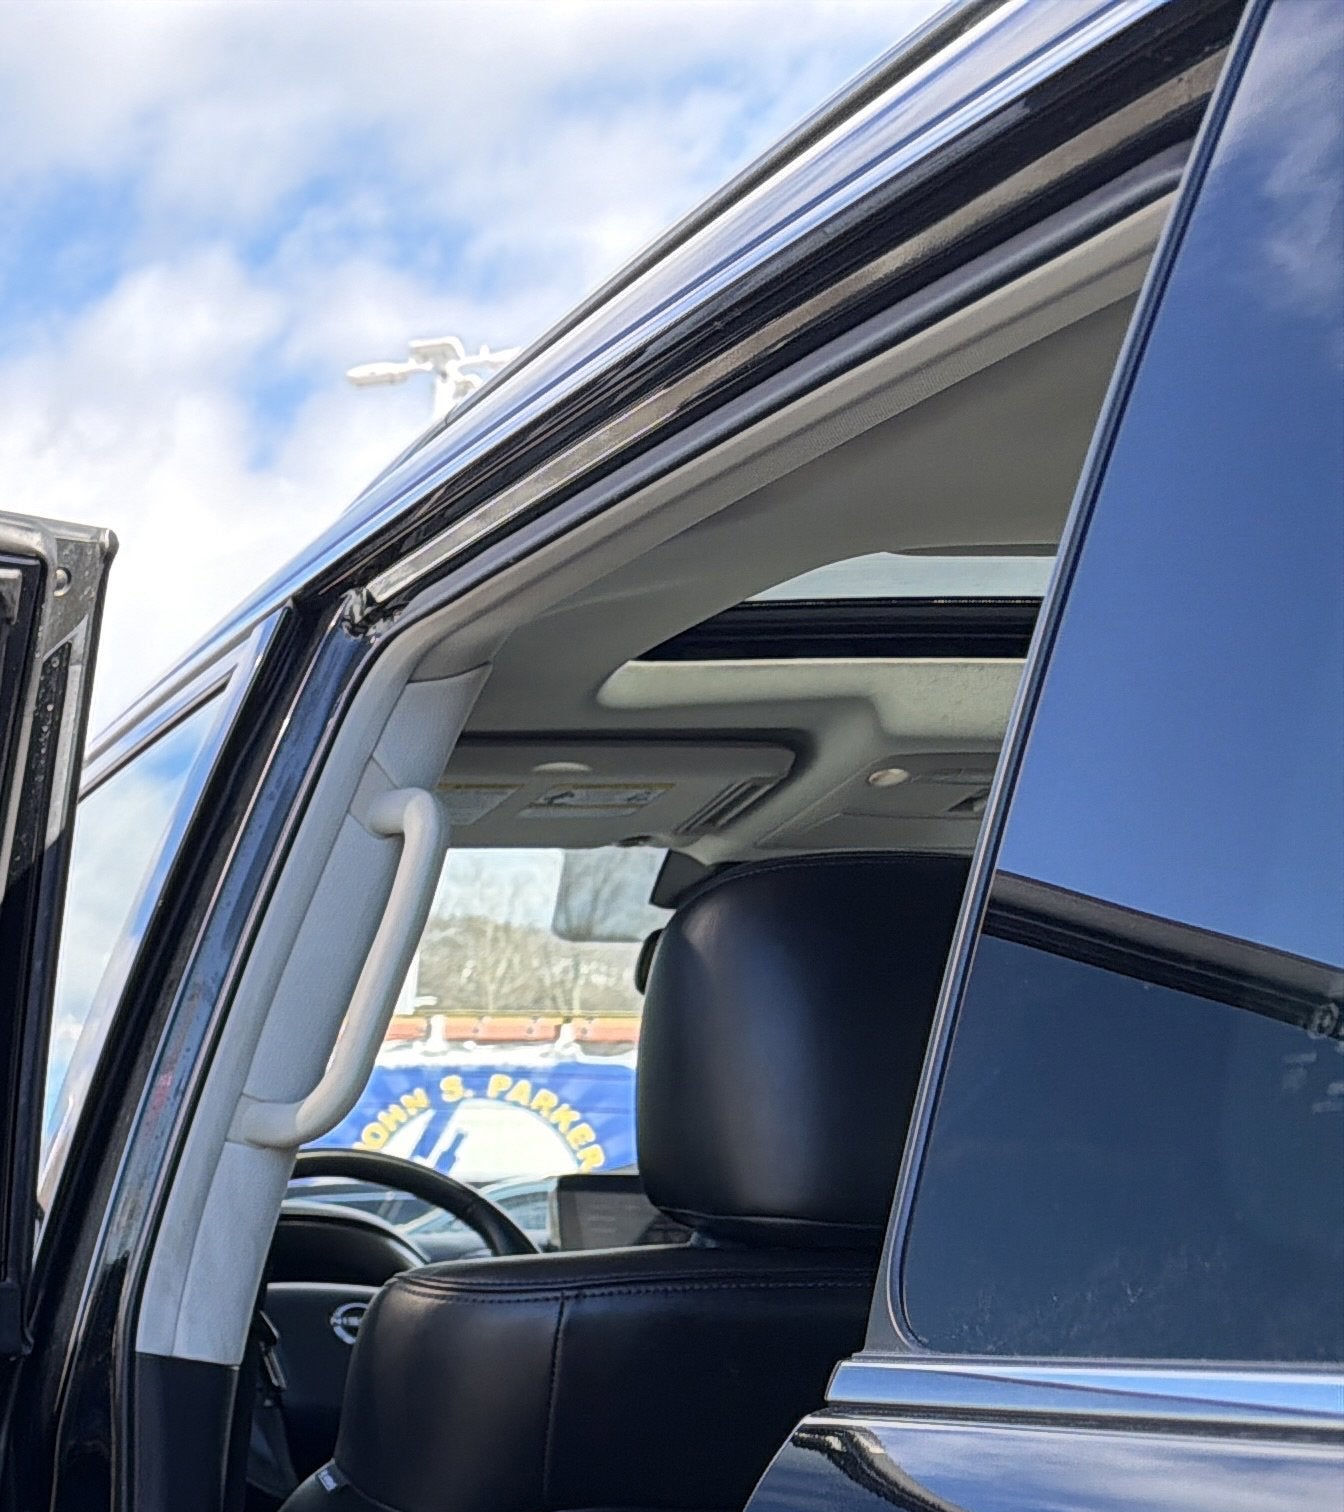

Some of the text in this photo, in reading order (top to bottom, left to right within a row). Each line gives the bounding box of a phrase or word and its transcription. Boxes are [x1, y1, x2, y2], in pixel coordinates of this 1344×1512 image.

[353, 1073, 605, 1174] OHN S. PARKER
